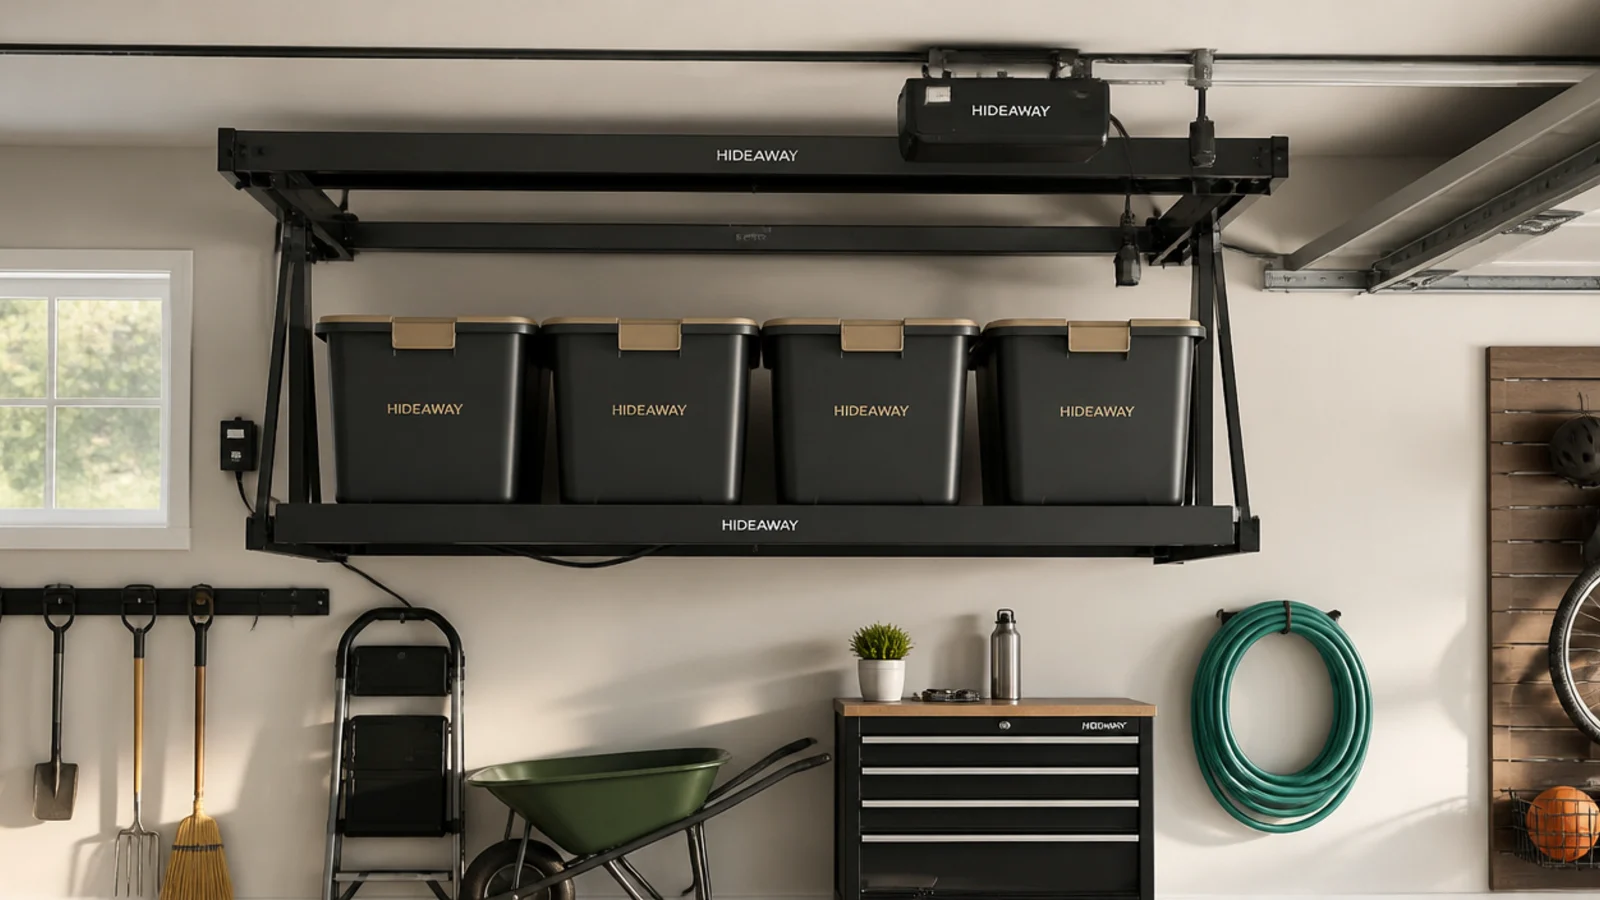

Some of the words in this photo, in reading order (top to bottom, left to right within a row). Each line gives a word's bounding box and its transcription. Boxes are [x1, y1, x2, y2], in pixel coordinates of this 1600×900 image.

[971, 104, 1051, 118] HIDEAWAY
[716, 149, 799, 162] HIDEAWAY
[387, 403, 464, 416] HIDEAWAY
[612, 404, 688, 417] HIDEAWAY
[833, 404, 910, 417] HIDEAWAY
[1059, 405, 1135, 418] HIDEAWAY
[721, 519, 799, 532] HIDEAWAY
